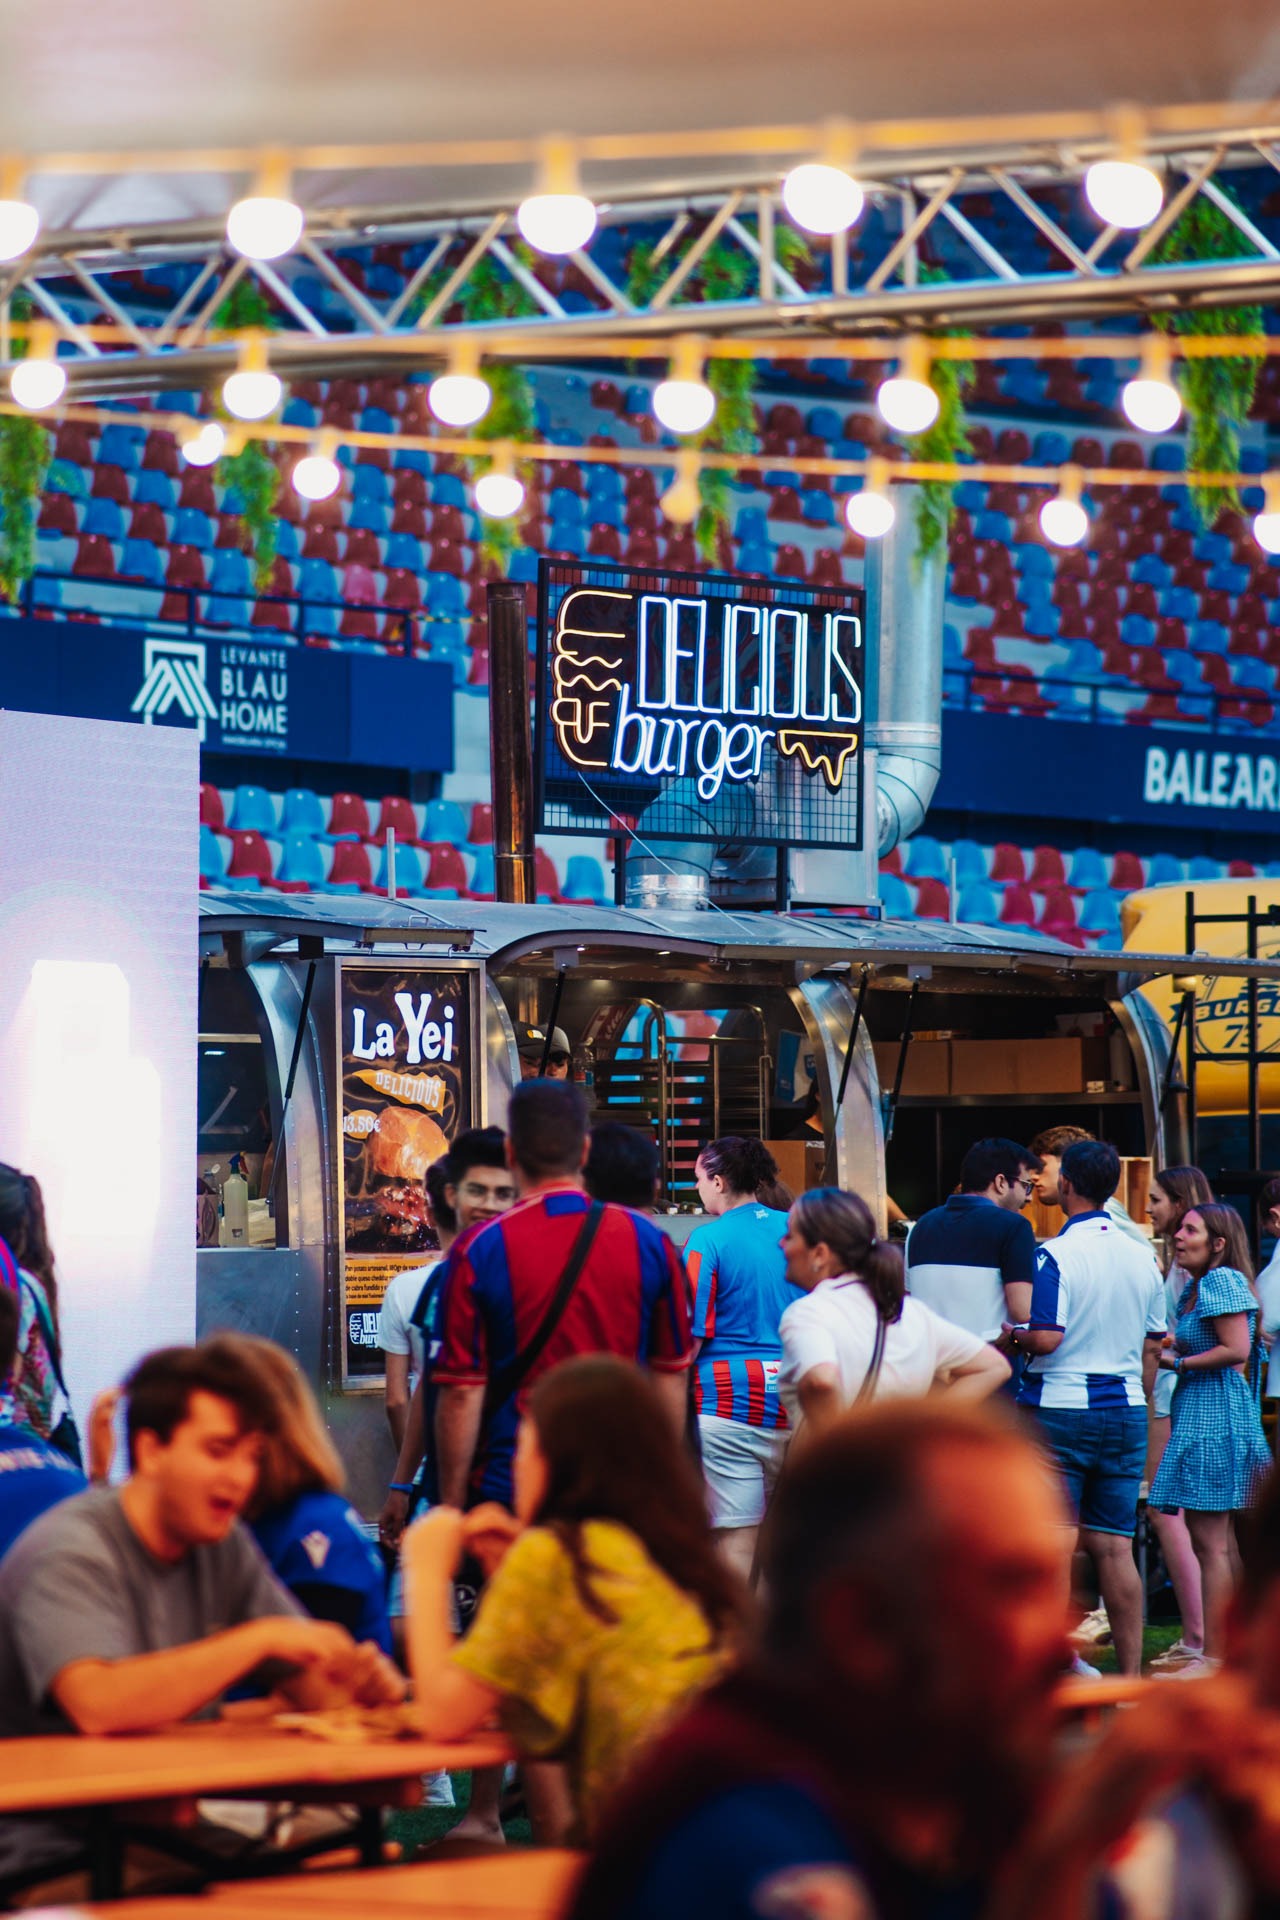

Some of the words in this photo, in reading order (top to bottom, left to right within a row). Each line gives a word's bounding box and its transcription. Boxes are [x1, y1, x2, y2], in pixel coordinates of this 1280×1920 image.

[221, 645, 287, 669] LEVANTE
[637, 595, 861, 723] DELICIOUS
[221, 666, 287, 702] BLAU
[220, 700, 288, 734] HOME
[611, 683, 776, 800] burger
[1144, 746, 1280, 812] BALEAR
[352, 1007, 395, 1060] La
[394, 992, 454, 1064] Yei
[375, 1071, 441, 1108] DELICIOUS
[343, 1115, 382, 1133] 13.50€
